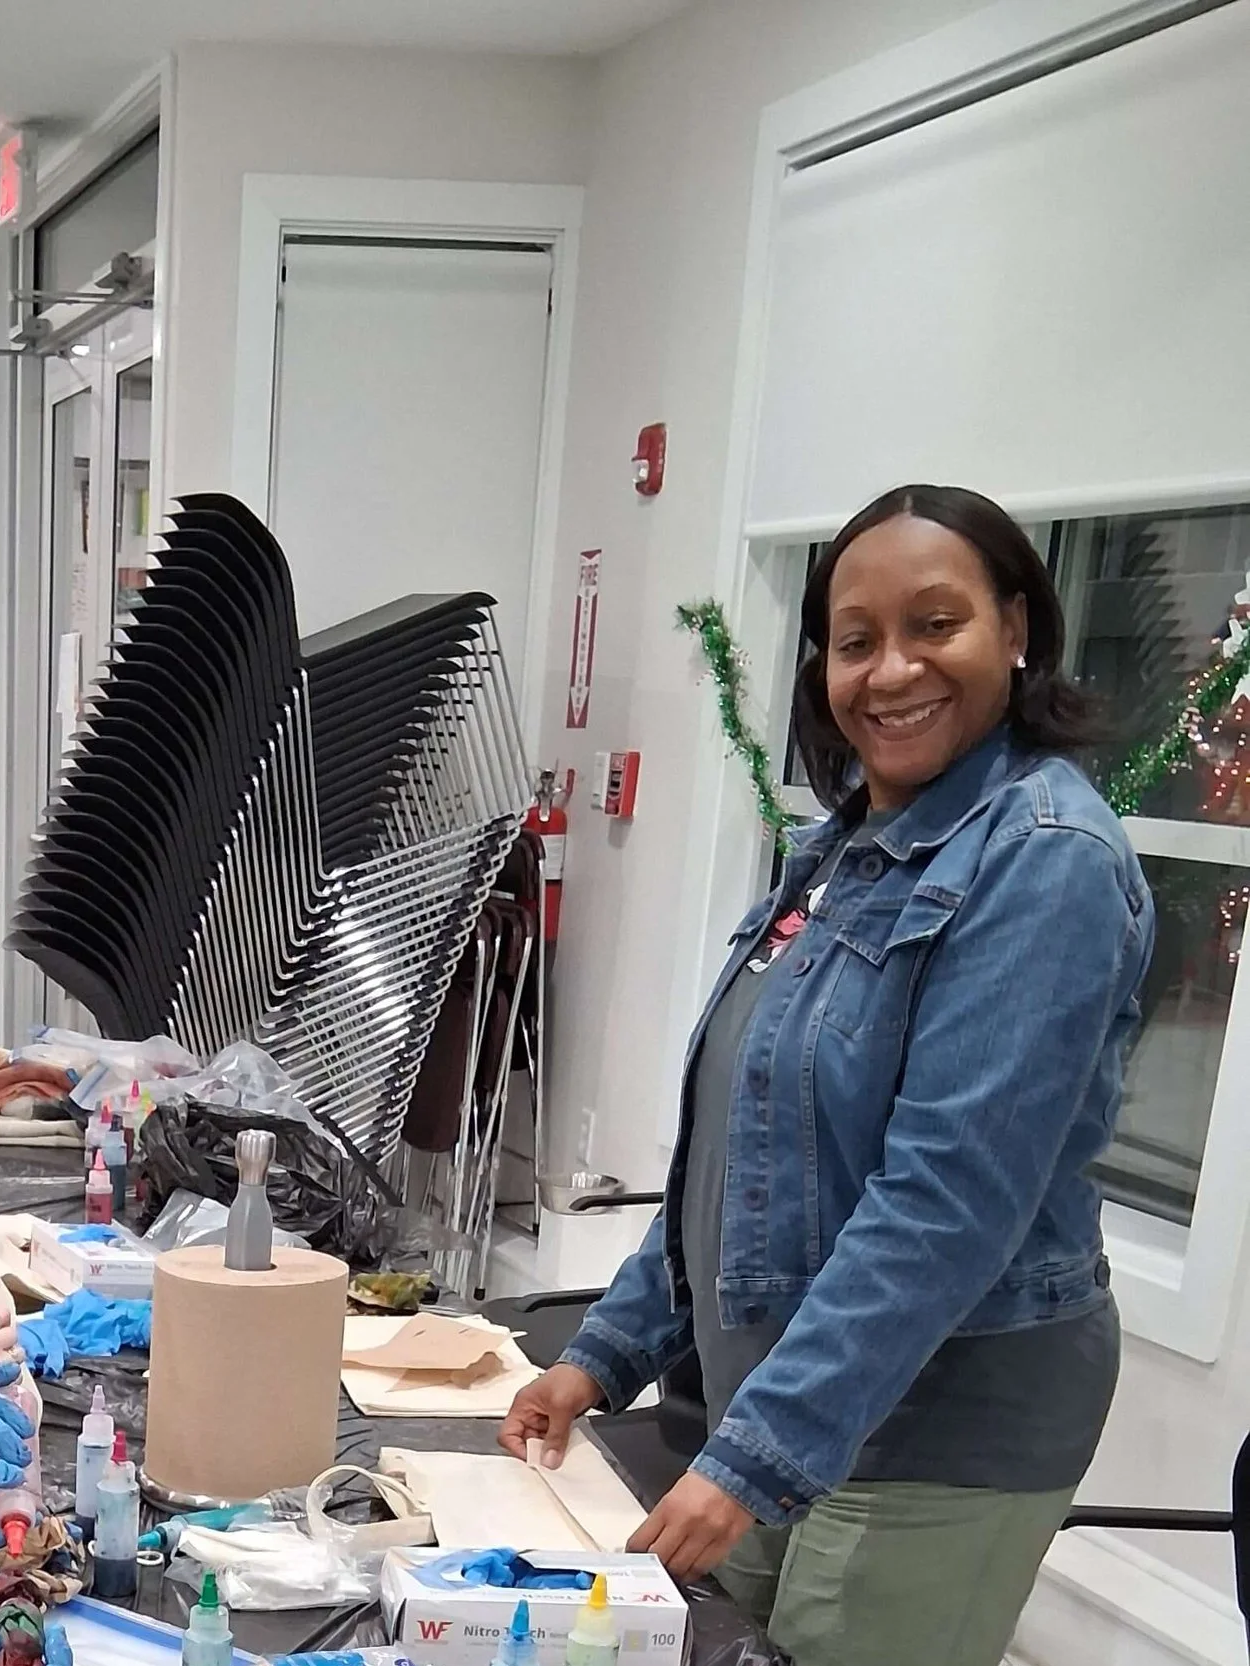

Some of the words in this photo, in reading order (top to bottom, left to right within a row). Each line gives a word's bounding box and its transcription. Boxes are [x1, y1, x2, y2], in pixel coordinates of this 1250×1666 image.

[463, 1625, 500, 1637] Nitro
[504, 1626, 546, 1639] Tch
[651, 1633, 676, 1646] 100
